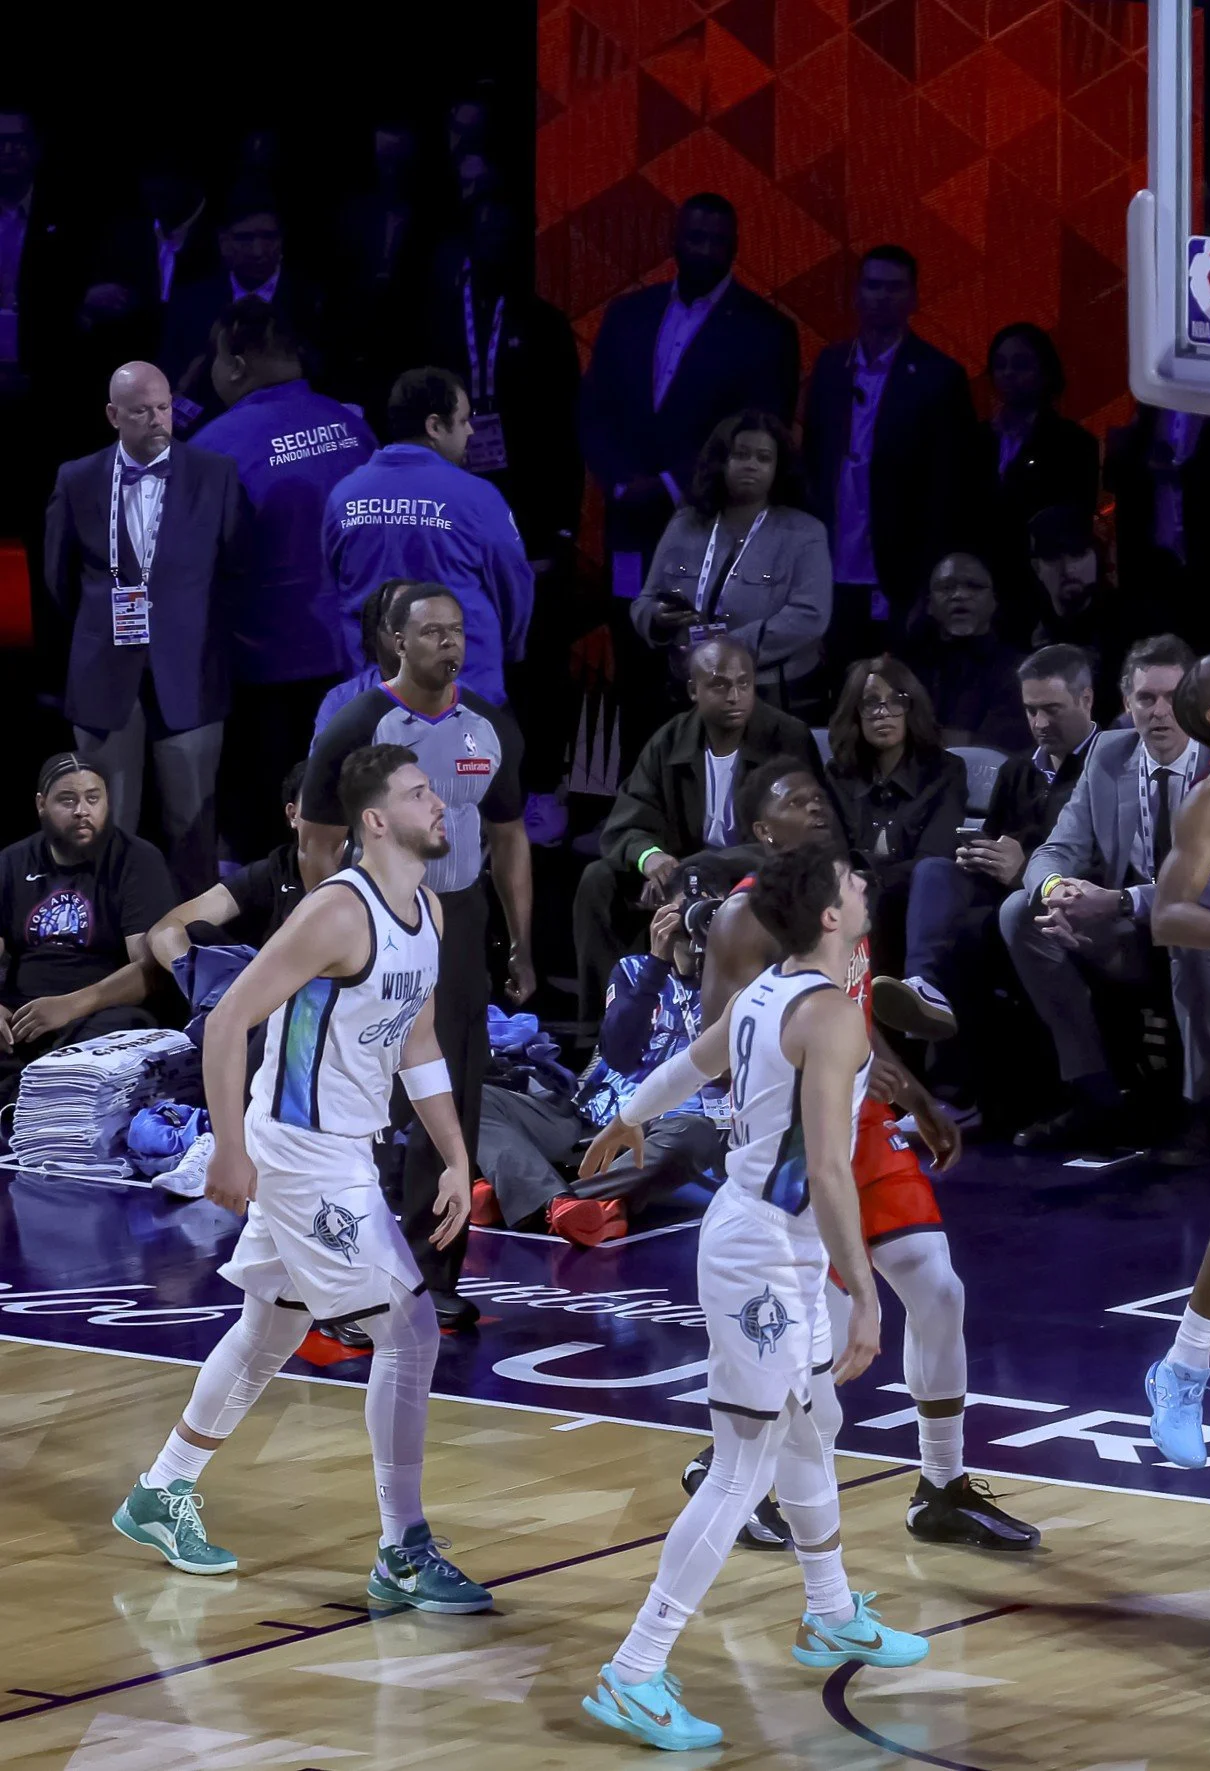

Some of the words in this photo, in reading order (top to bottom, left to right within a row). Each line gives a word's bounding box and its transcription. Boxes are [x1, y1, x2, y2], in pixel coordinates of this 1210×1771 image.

[271, 422, 349, 453] SECURITY
[269, 447, 311, 466] FANDOM
[311, 441, 338, 456] LIVES
[338, 437, 359, 449] HERE
[346, 498, 446, 517] SECURITY
[341, 515, 382, 529] FANDOM
[384, 515, 417, 525] LIVES
[420, 516, 452, 530] HERE
[456, 761, 490, 772] Emirates
[29, 906, 47, 932] LOS
[733, 1015, 756, 1111] 8
